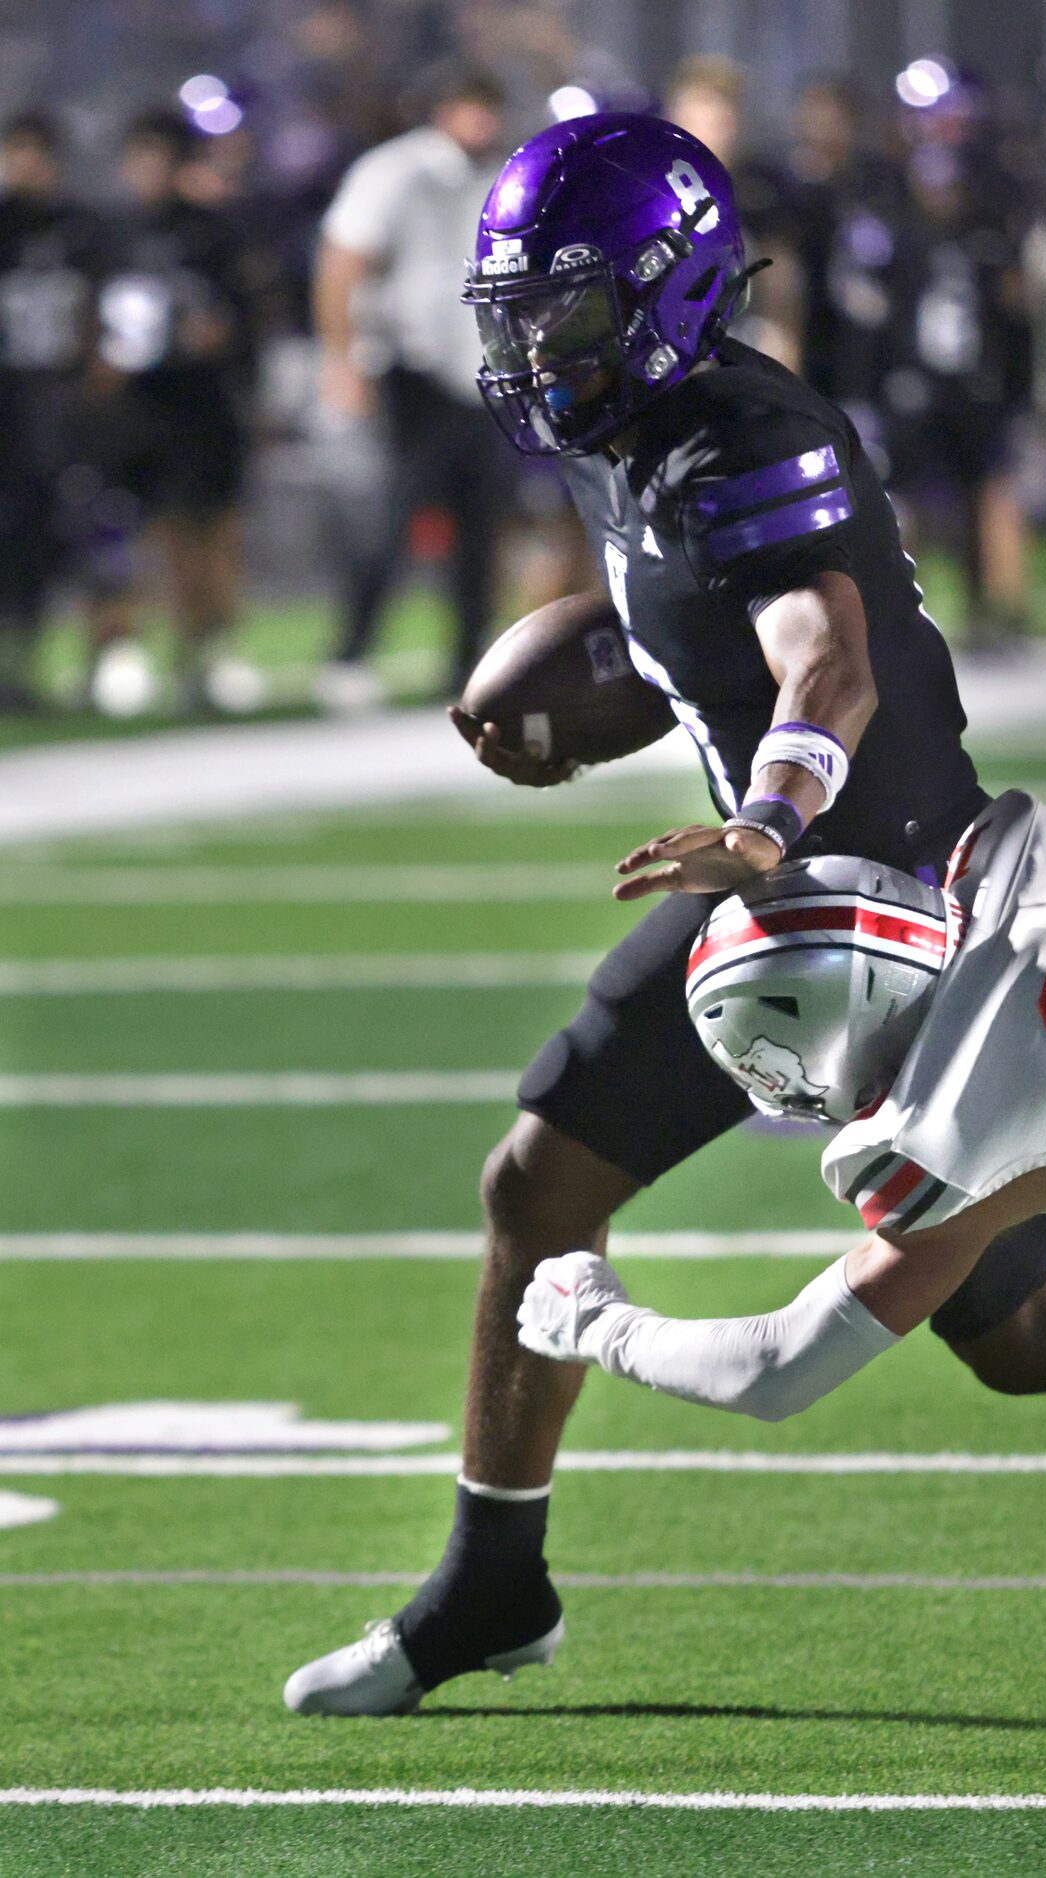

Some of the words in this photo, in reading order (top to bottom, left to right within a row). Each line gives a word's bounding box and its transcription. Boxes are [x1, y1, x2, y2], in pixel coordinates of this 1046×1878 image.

[665, 158, 720, 235] 8
[482, 255, 529, 276] Riddell
[555, 255, 600, 272] OAKLEY
